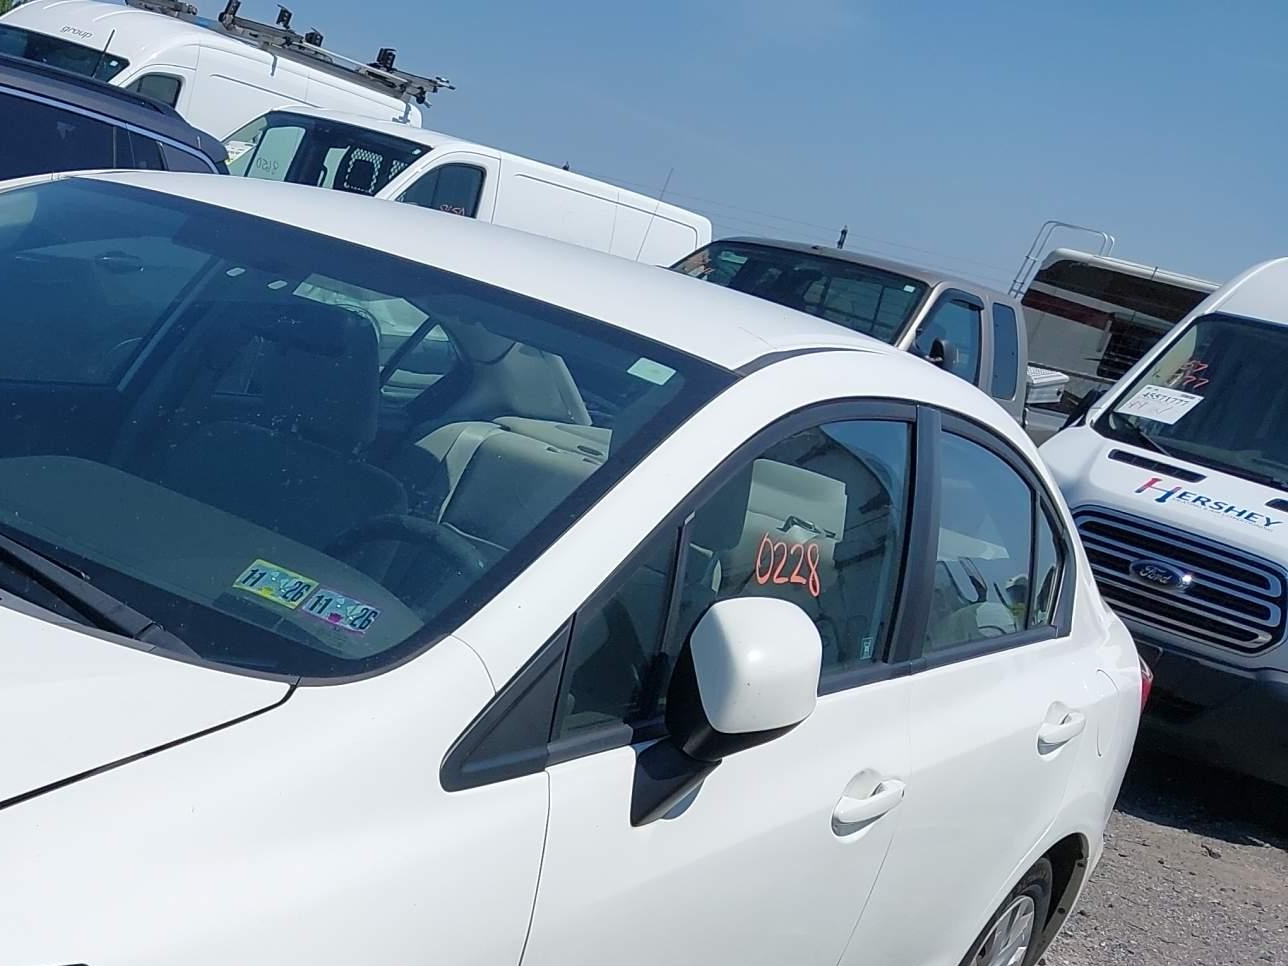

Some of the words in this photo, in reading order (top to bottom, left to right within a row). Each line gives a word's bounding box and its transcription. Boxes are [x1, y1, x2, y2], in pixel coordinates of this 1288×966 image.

[60, 25, 93, 39] group
[1134, 477, 1283, 528] HERSHEY
[756, 532, 820, 597] 0228
[1139, 565, 1173, 584] Ford
[242, 568, 266, 587] 11
[281, 580, 312, 602] 26
[309, 594, 333, 614] 11
[349, 607, 379, 630] 26
